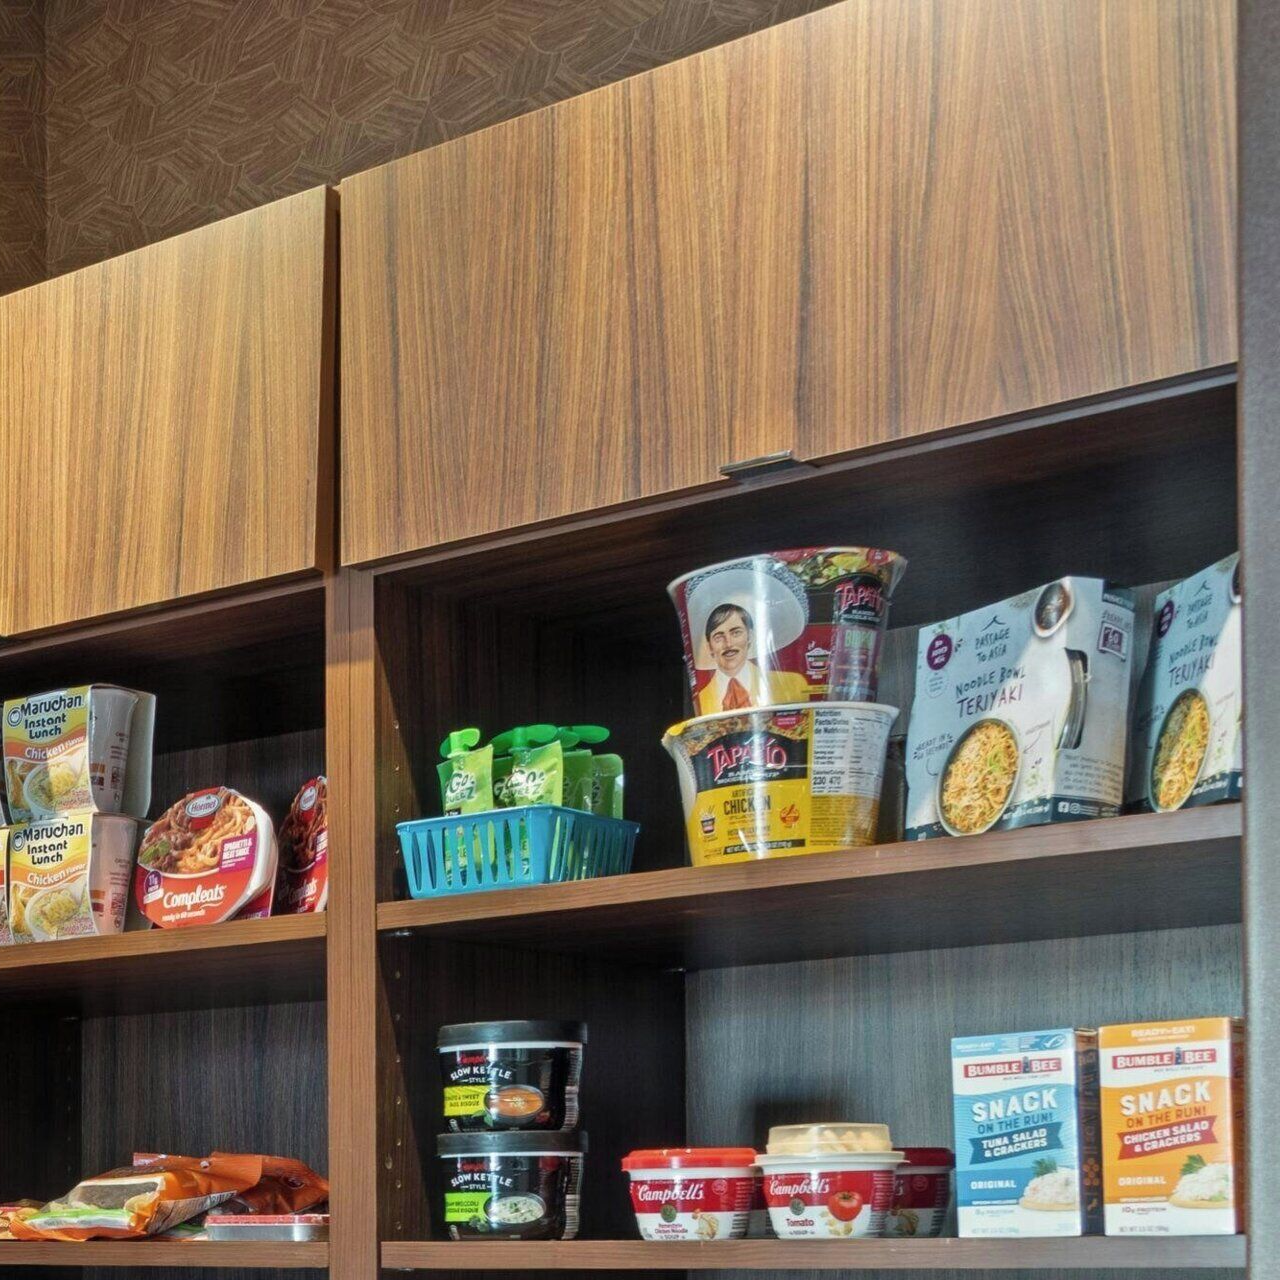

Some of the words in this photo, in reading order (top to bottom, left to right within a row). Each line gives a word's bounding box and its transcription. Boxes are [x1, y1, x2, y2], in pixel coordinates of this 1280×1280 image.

[956, 671, 997, 698] NOODLE
[1000, 664, 1026, 682] BOWL
[21, 694, 83, 718] Maruchan
[956, 682, 1023, 719] TERIYAKI
[25, 713, 67, 730] Instant
[29, 724, 62, 739] Lunch
[24, 741, 64, 760] Chicken
[23, 821, 84, 845] Maruchan
[27, 839, 68, 855] Instant
[32, 851, 63, 865] Lunch
[27, 868, 65, 886] Chicken
[163, 883, 225, 909] Compleats
[968, 1062, 1020, 1077] BUMBLE
[1032, 1058, 1059, 1072] BEE
[1116, 1053, 1172, 1069] BUMBLE
[1184, 1050, 1215, 1063] BEE
[450, 1067, 471, 1081] SLOW
[473, 1066, 512, 1080] KETTLE
[972, 1088, 1058, 1122] SNACK
[1121, 1080, 1211, 1116] SNACK
[978, 1122, 994, 1134] ON
[997, 1119, 1019, 1130] THE
[1023, 1113, 1054, 1127] RUN!
[1126, 1117, 1145, 1129] ON
[1155, 1112, 1177, 1123] THE
[1180, 1106, 1207, 1120] RUN!
[981, 1137, 1009, 1149] TUNA
[1012, 1128, 1048, 1144] SALAD
[1124, 1128, 1165, 1145] CHICKEN
[1167, 1121, 1209, 1137] SALAD
[1144, 1132, 1202, 1151] CRACKERS
[993, 1137, 1048, 1156] CRACKERS
[451, 1173, 471, 1187] SLOW
[473, 1173, 512, 1187] KETTLE
[770, 1175, 830, 1195] Campbell's
[970, 1179, 1016, 1189] ORIGINAL
[1118, 1176, 1166, 1186] ORIGINAL
[637, 1180, 705, 1202] Campbell's
[786, 1218, 815, 1227] Tomato
